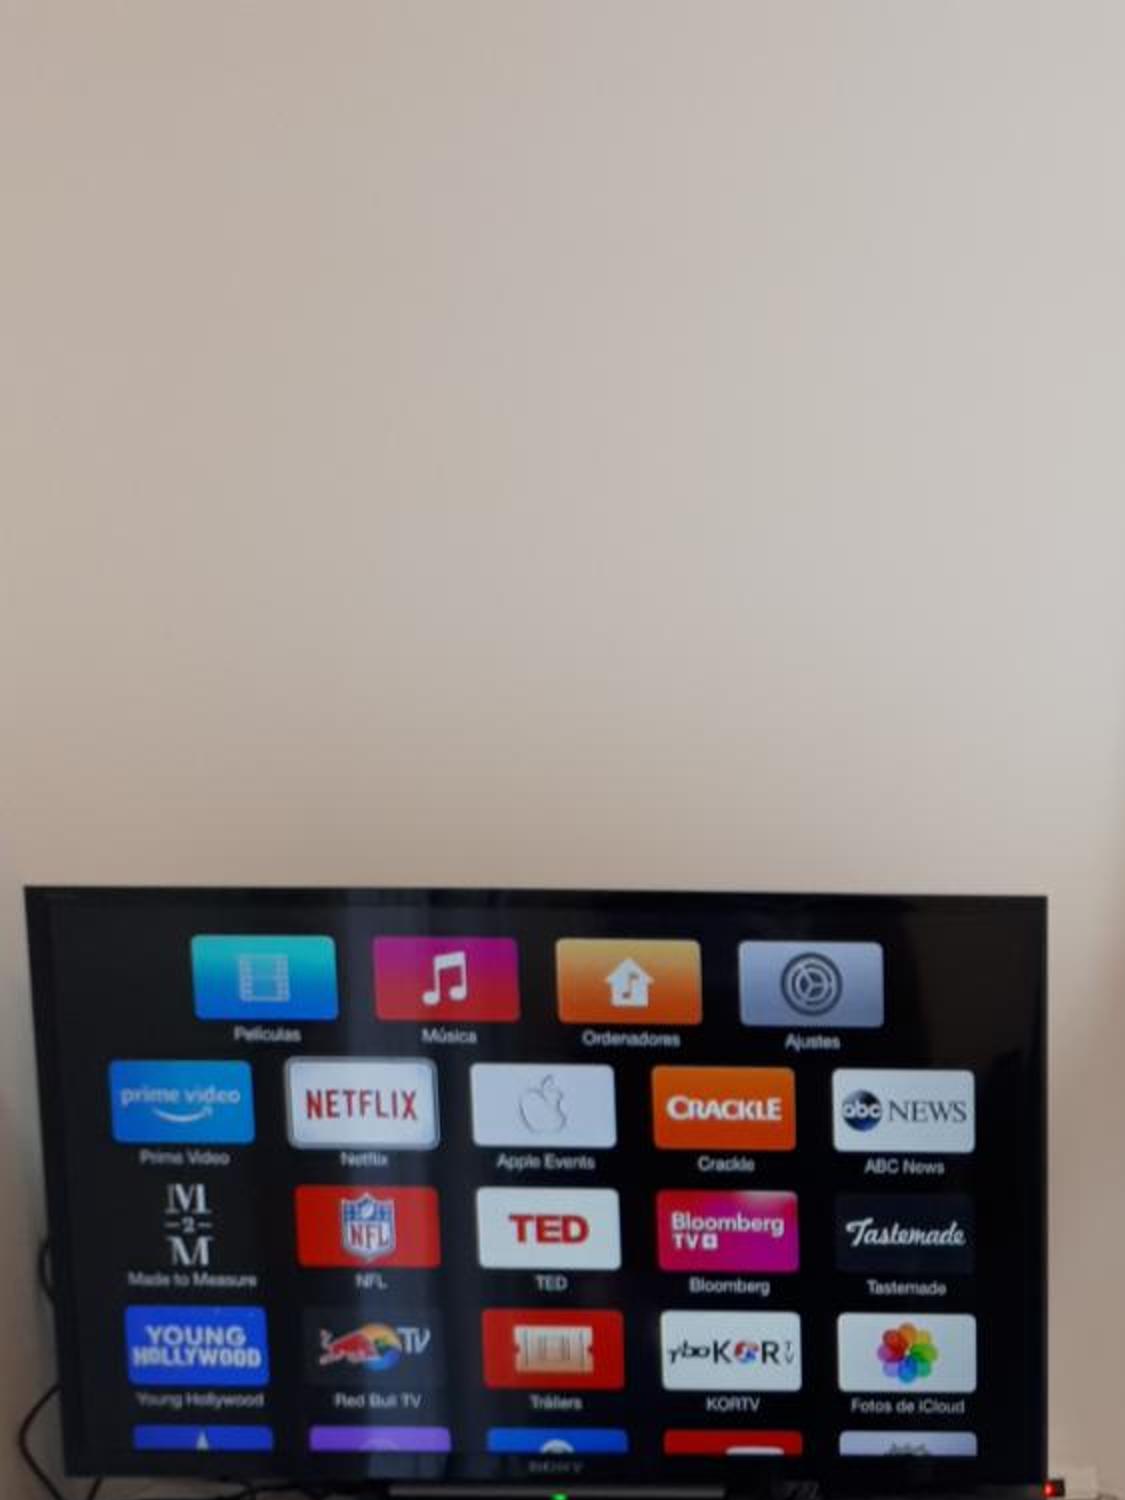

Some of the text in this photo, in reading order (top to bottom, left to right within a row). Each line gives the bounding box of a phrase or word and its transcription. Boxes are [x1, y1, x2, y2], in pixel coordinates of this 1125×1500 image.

[421, 1026, 478, 1045] Música
[581, 1029, 681, 1048] Ordenadores
[784, 1032, 841, 1052] Ajustes
[121, 1083, 240, 1107] prime video
[306, 1088, 417, 1120] NETFLIX
[666, 1095, 783, 1121] CRACKLE
[841, 1100, 968, 1122] abc NEWS
[139, 1147, 231, 1166] Prime Video
[340, 1151, 389, 1168] Netflix
[496, 1152, 596, 1171] Apple Events
[697, 1155, 756, 1172] Crackle
[863, 1157, 945, 1175] ABC News
[164, 1182, 213, 1215] M
[349, 1222, 392, 1248] NFL
[508, 1213, 590, 1244] TED
[672, 1211, 785, 1239] Bloomberg
[845, 1217, 967, 1247] Tastemade
[164, 1235, 214, 1266] M
[128, 1271, 258, 1288] Made to Measure
[355, 1271, 389, 1290] NFL
[535, 1273, 569, 1291] TED
[688, 1277, 771, 1298] Bloomberg
[866, 1279, 948, 1297] Tastemade
[144, 1324, 246, 1347] YOUNG
[397, 1326, 431, 1354] TV
[131, 1345, 262, 1368] HOLLYWOOD
[136, 1390, 265, 1410] Young Hollywood
[333, 1391, 422, 1408] Red Bull TV
[705, 1396, 761, 1412] KORTV
[850, 1397, 966, 1415] Fotos de iCloud
